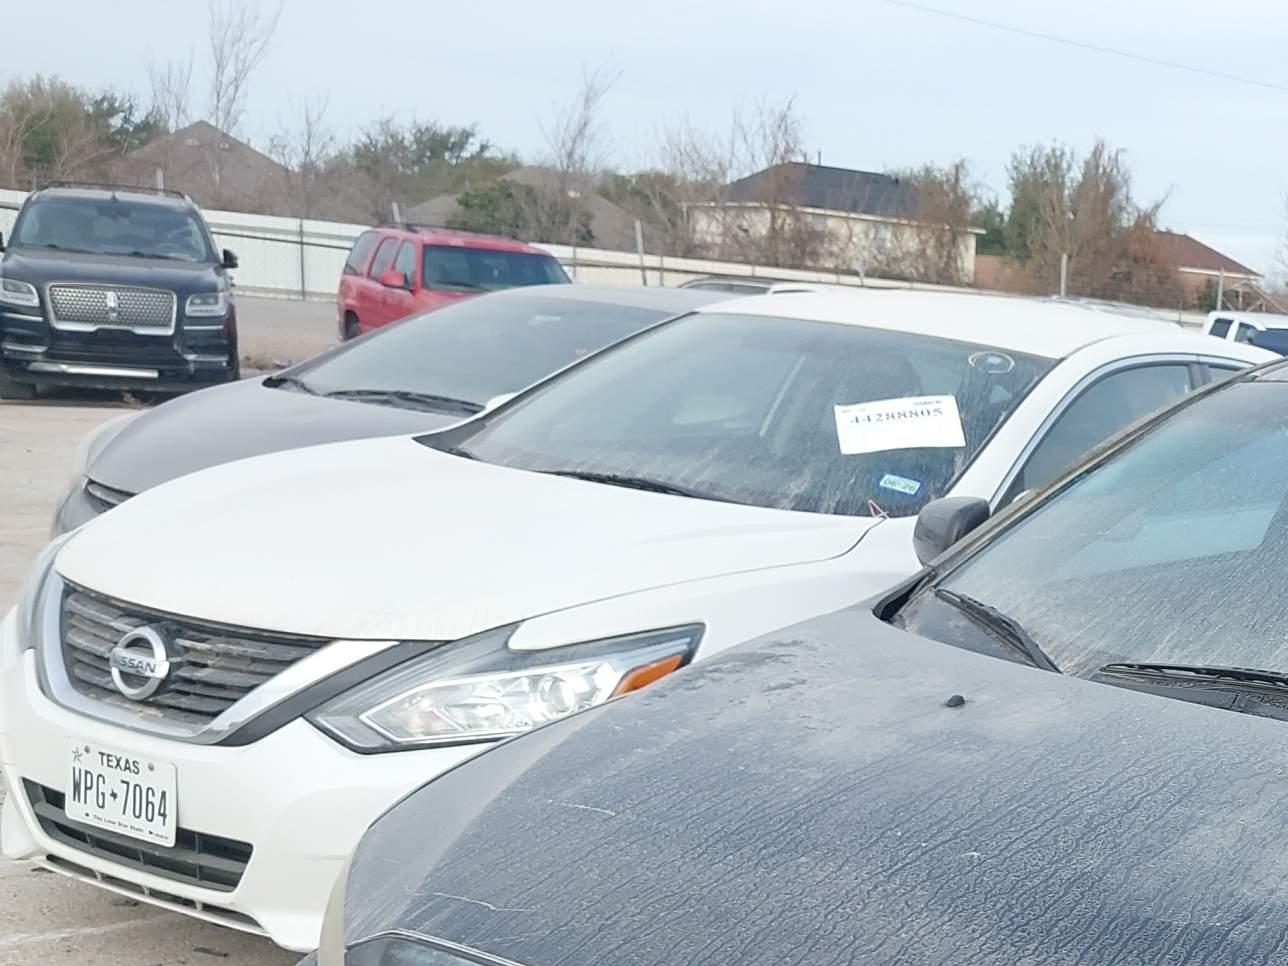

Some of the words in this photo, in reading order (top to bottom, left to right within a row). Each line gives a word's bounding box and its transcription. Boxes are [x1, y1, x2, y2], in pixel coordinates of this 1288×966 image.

[850, 407, 943, 424] 44288805
[112, 652, 157, 674] SSAN
[98, 751, 140, 775] TEXAS
